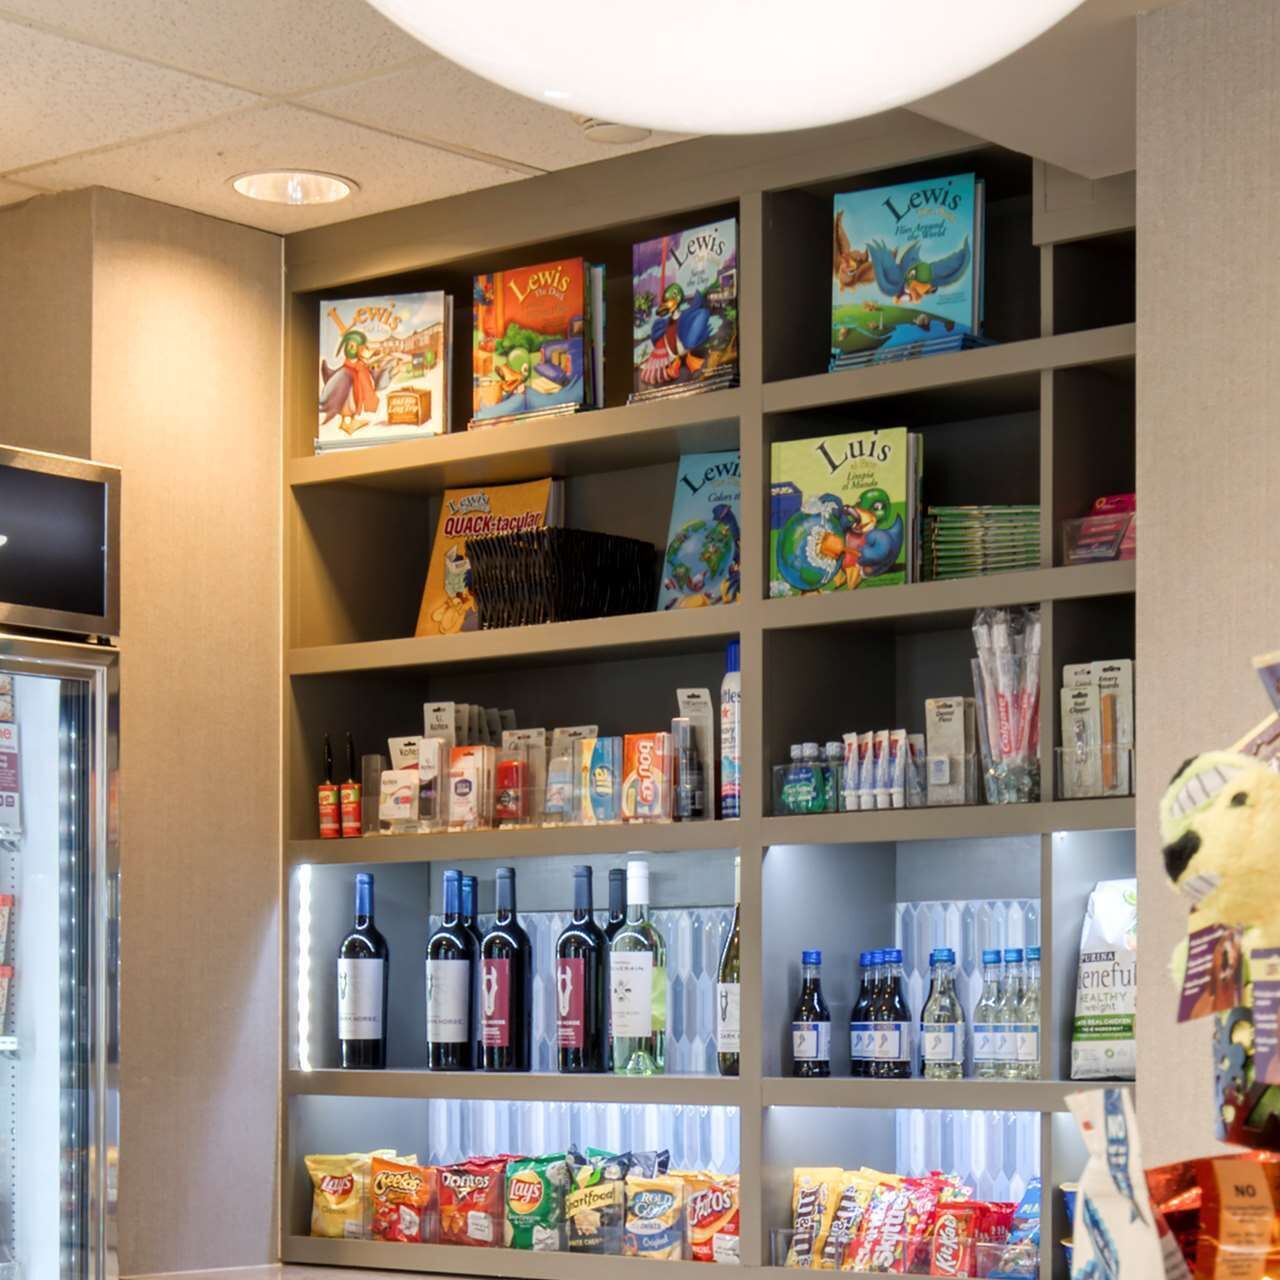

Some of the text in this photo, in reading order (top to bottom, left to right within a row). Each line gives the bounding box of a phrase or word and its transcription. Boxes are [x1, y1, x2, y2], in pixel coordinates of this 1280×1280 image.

[882, 180, 962, 224] Lewis
[670, 228, 726, 270] Lewis
[508, 266, 571, 304] Lewis
[816, 430, 892, 475] Luis
[679, 455, 742, 497] Lewi
[444, 511, 542, 538] QUACK-tacular
[593, 765, 613, 795] all
[442, 1172, 491, 1189] Doritos
[509, 1178, 543, 1204] Lay's
[1233, 1184, 1258, 1199] NO
